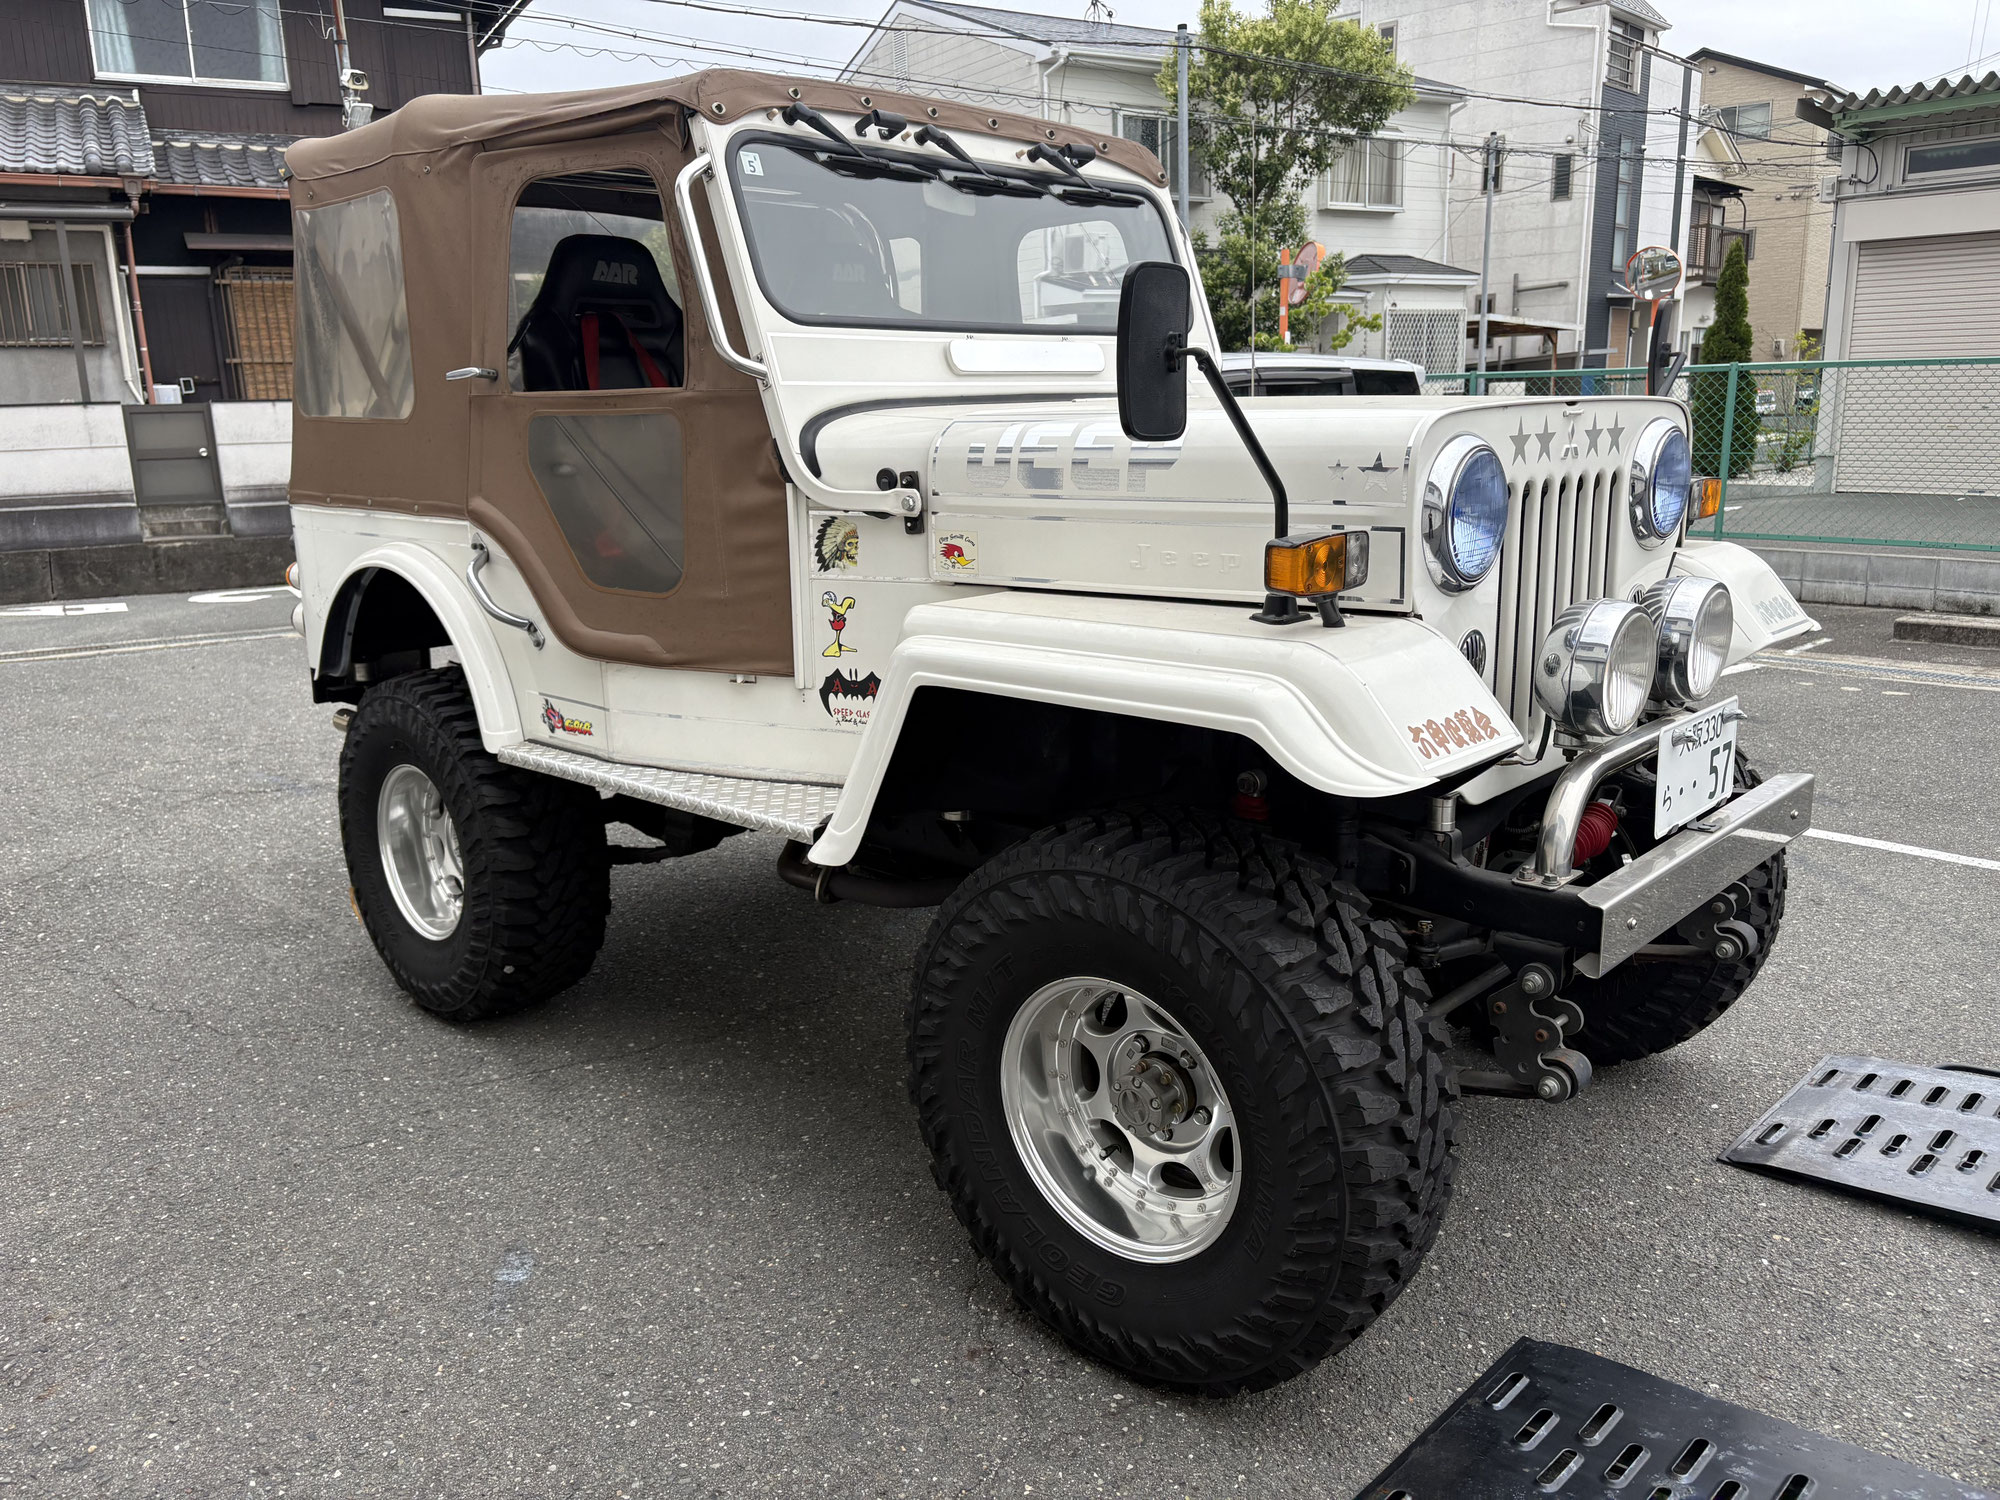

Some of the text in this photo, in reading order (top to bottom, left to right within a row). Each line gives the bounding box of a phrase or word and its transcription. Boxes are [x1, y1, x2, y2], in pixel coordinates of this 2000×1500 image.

[748, 160, 756, 173] 5
[966, 422, 1190, 492] JEEP
[1129, 543, 1241, 573] Jeep
[833, 707, 853, 717] SPEED
[967, 952, 1016, 1031] M/T
[1158, 972, 1275, 1262] YOKOHAMA
[957, 1039, 1128, 1307] GEOLANDAR
